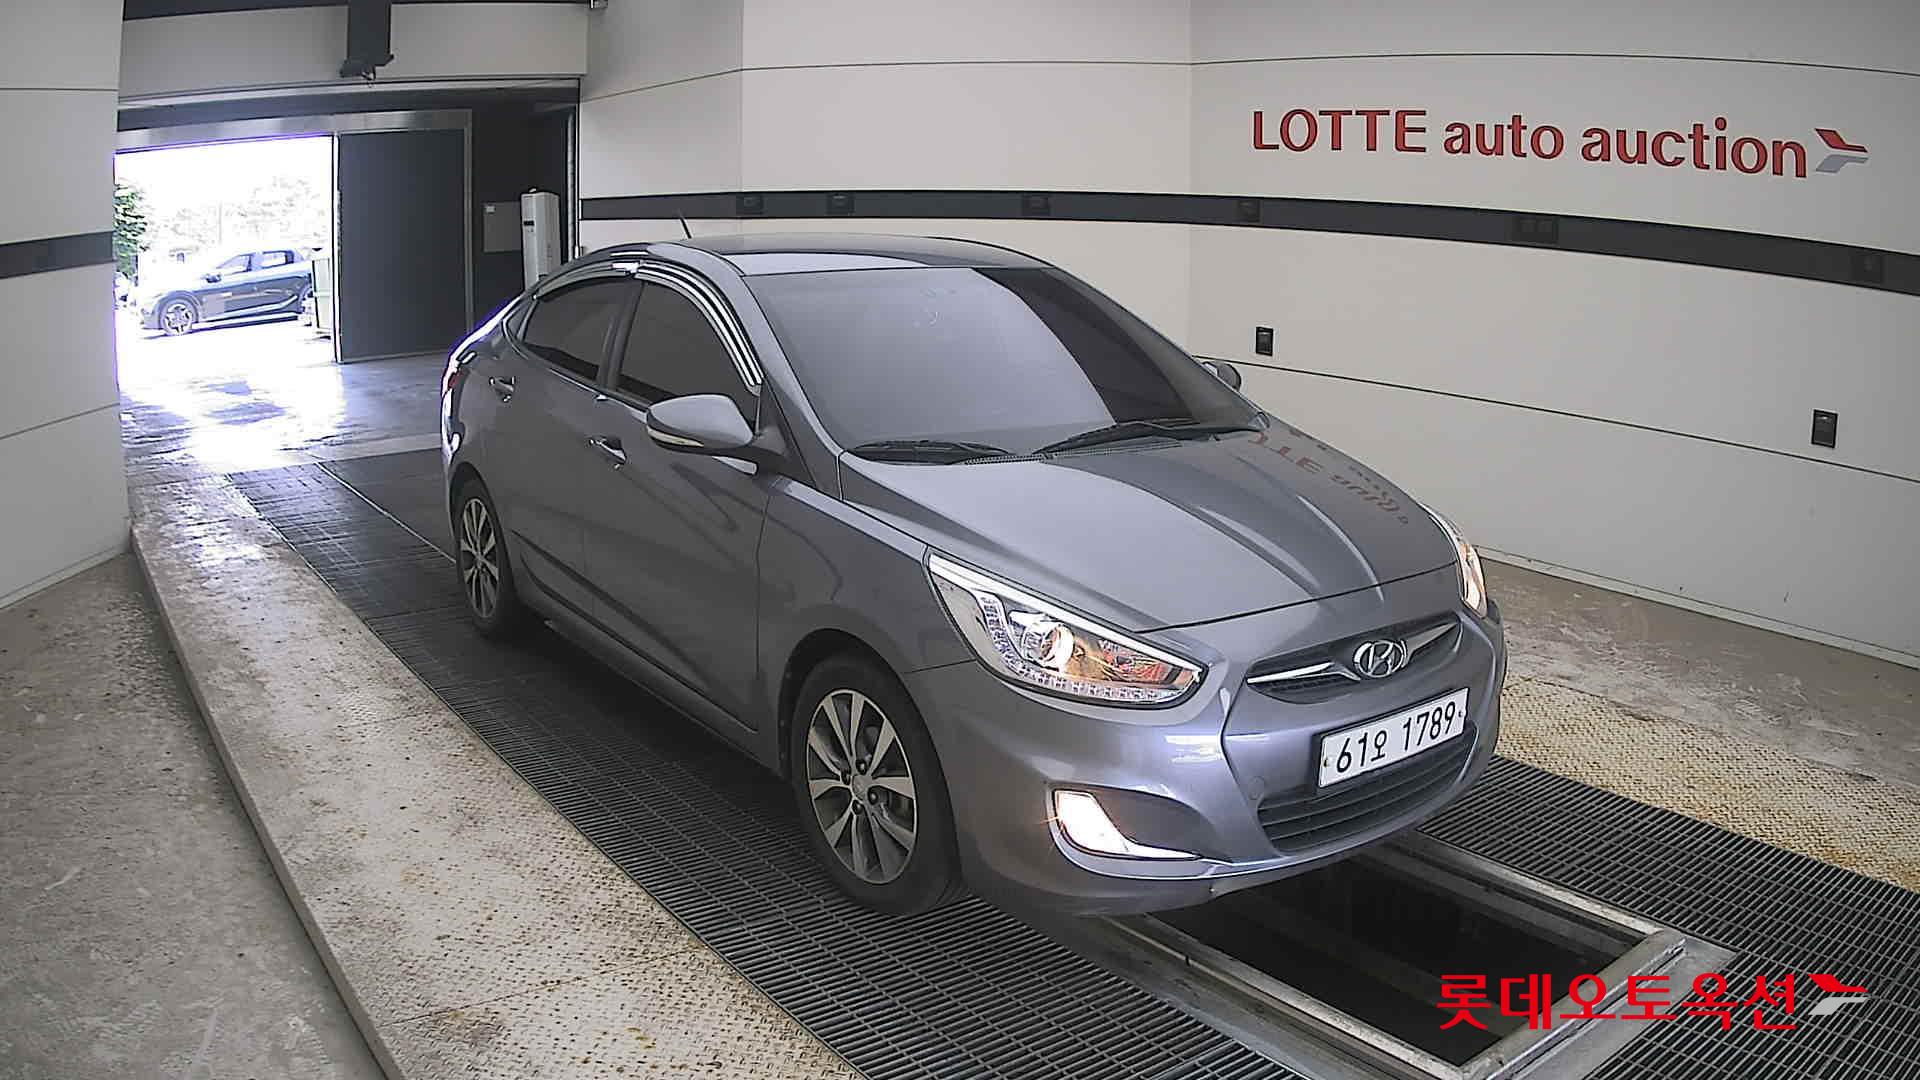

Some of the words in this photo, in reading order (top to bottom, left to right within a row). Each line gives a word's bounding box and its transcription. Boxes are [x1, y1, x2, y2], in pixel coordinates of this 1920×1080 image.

[1252, 109, 1427, 153] LOTTE
[1443, 115, 1565, 160] auto
[1581, 117, 1808, 178] auction
[1336, 730, 1388, 773] 61오
[1403, 701, 1456, 751] 1789
